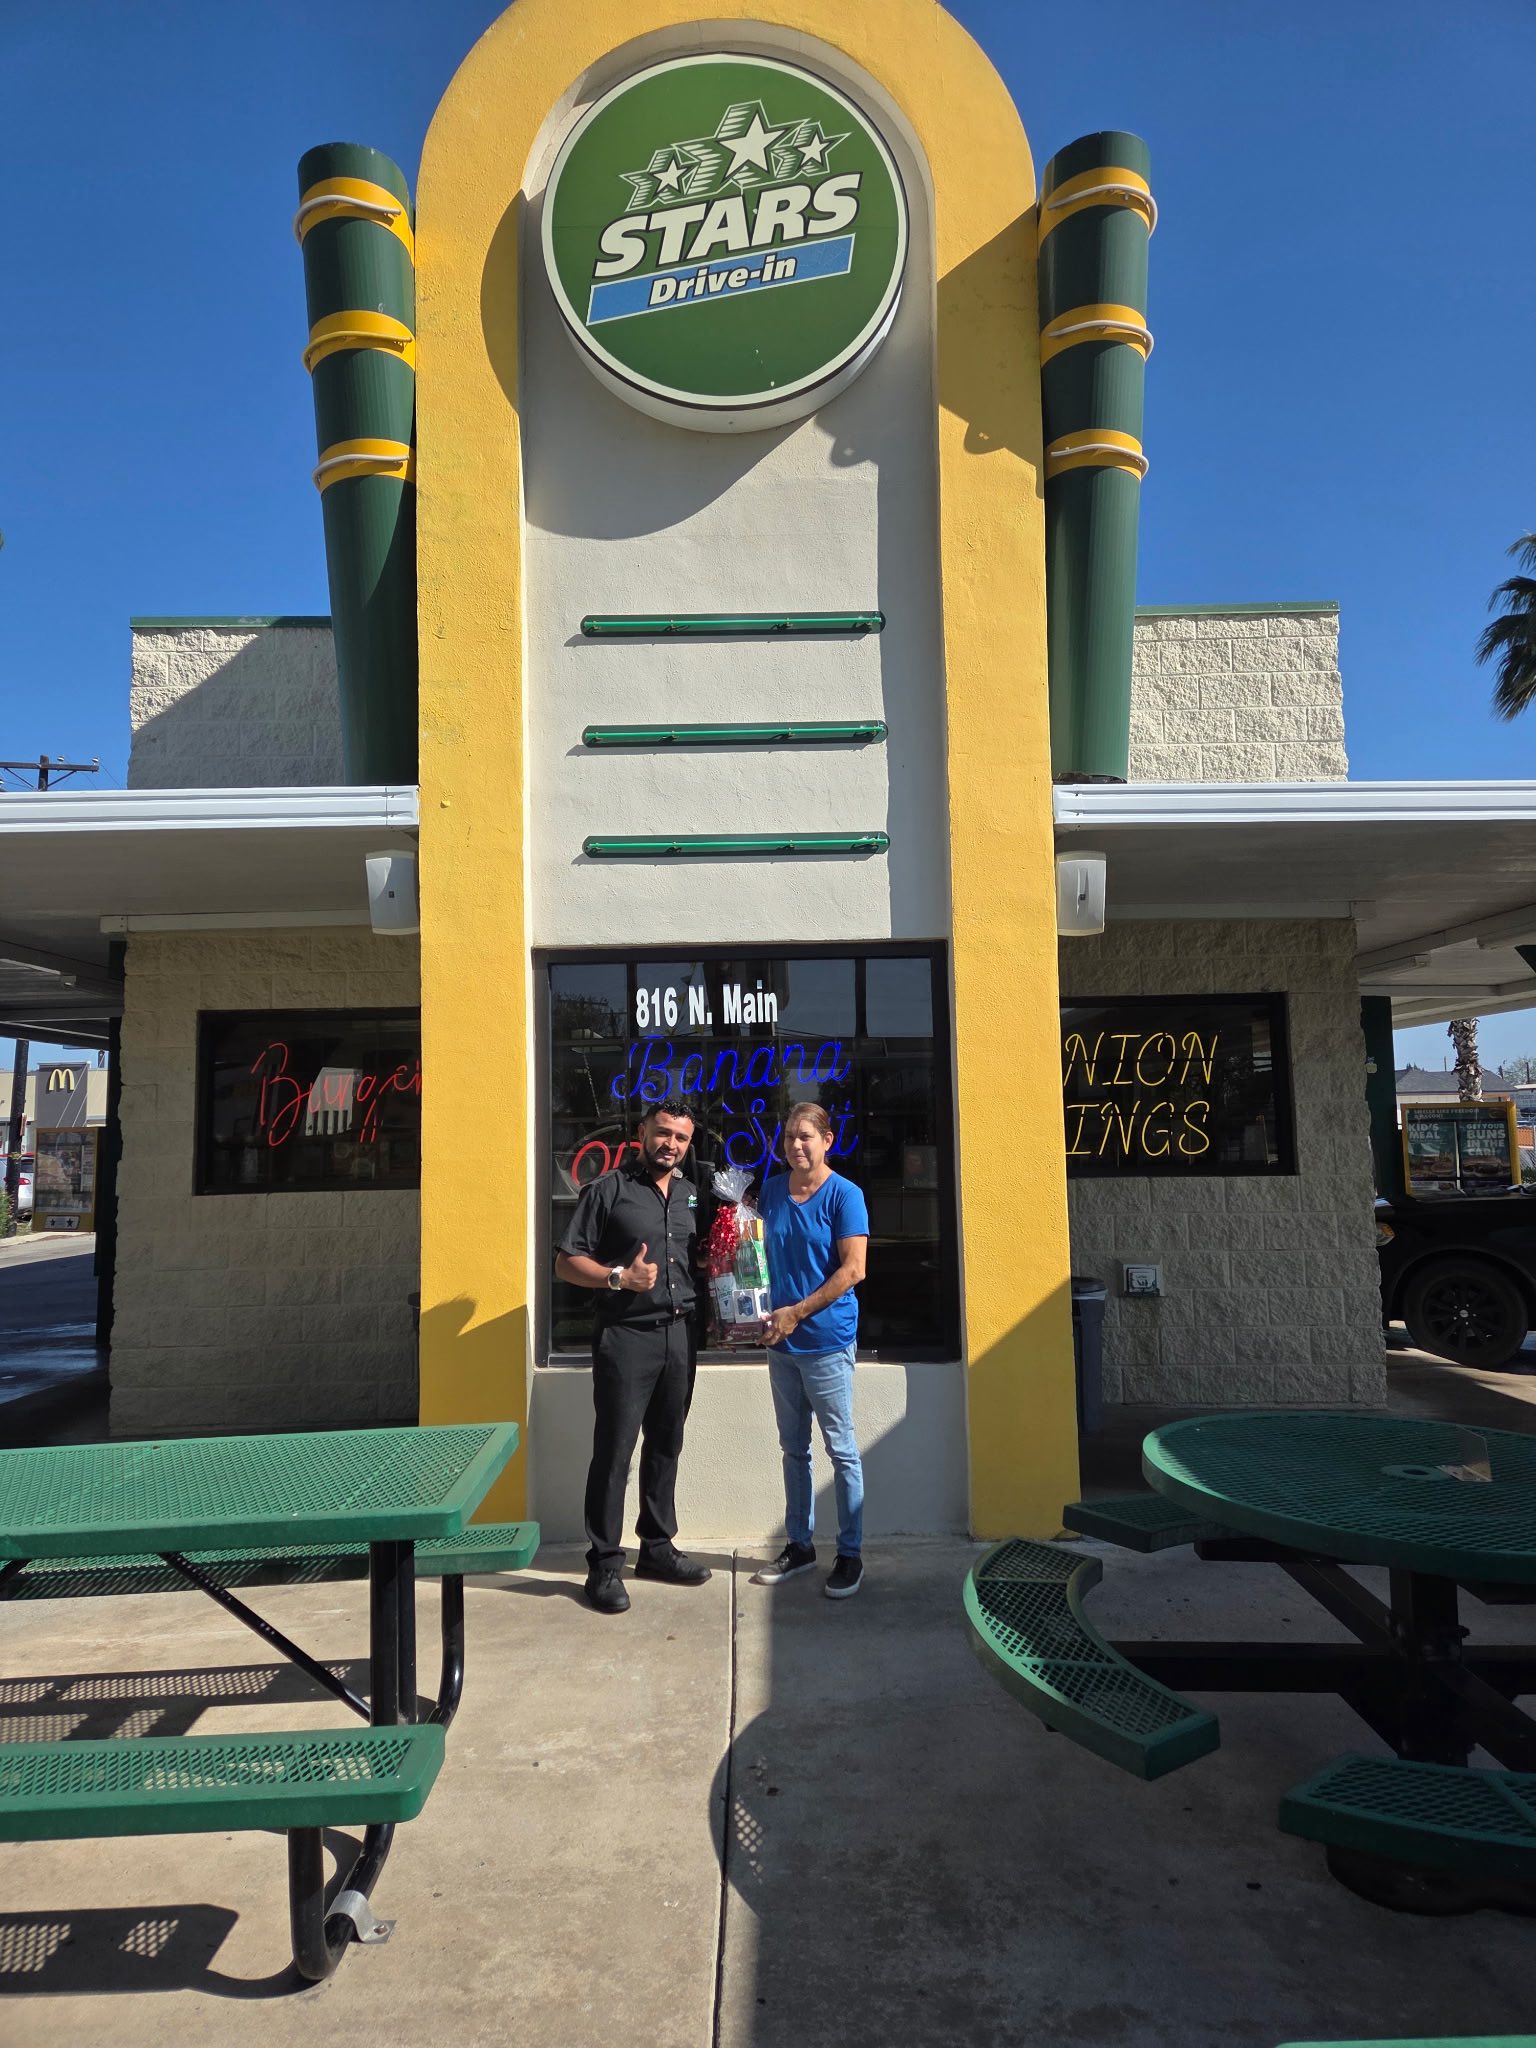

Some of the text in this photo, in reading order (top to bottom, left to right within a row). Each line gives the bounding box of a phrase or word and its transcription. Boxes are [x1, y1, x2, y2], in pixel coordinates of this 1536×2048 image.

[594, 172, 863, 278] STARS
[649, 255, 797, 306] Drive-in
[636, 979, 778, 1028] 816 N. Main
[611, 1035, 851, 1103] Banana
[1065, 1100, 1210, 1156] INGS
[1408, 1123, 1440, 1131] KID'S
[1408, 1131, 1441, 1139] MEAL
[1466, 1129, 1506, 1139] BUNS
[1466, 1139, 1505, 1148] IN THE
